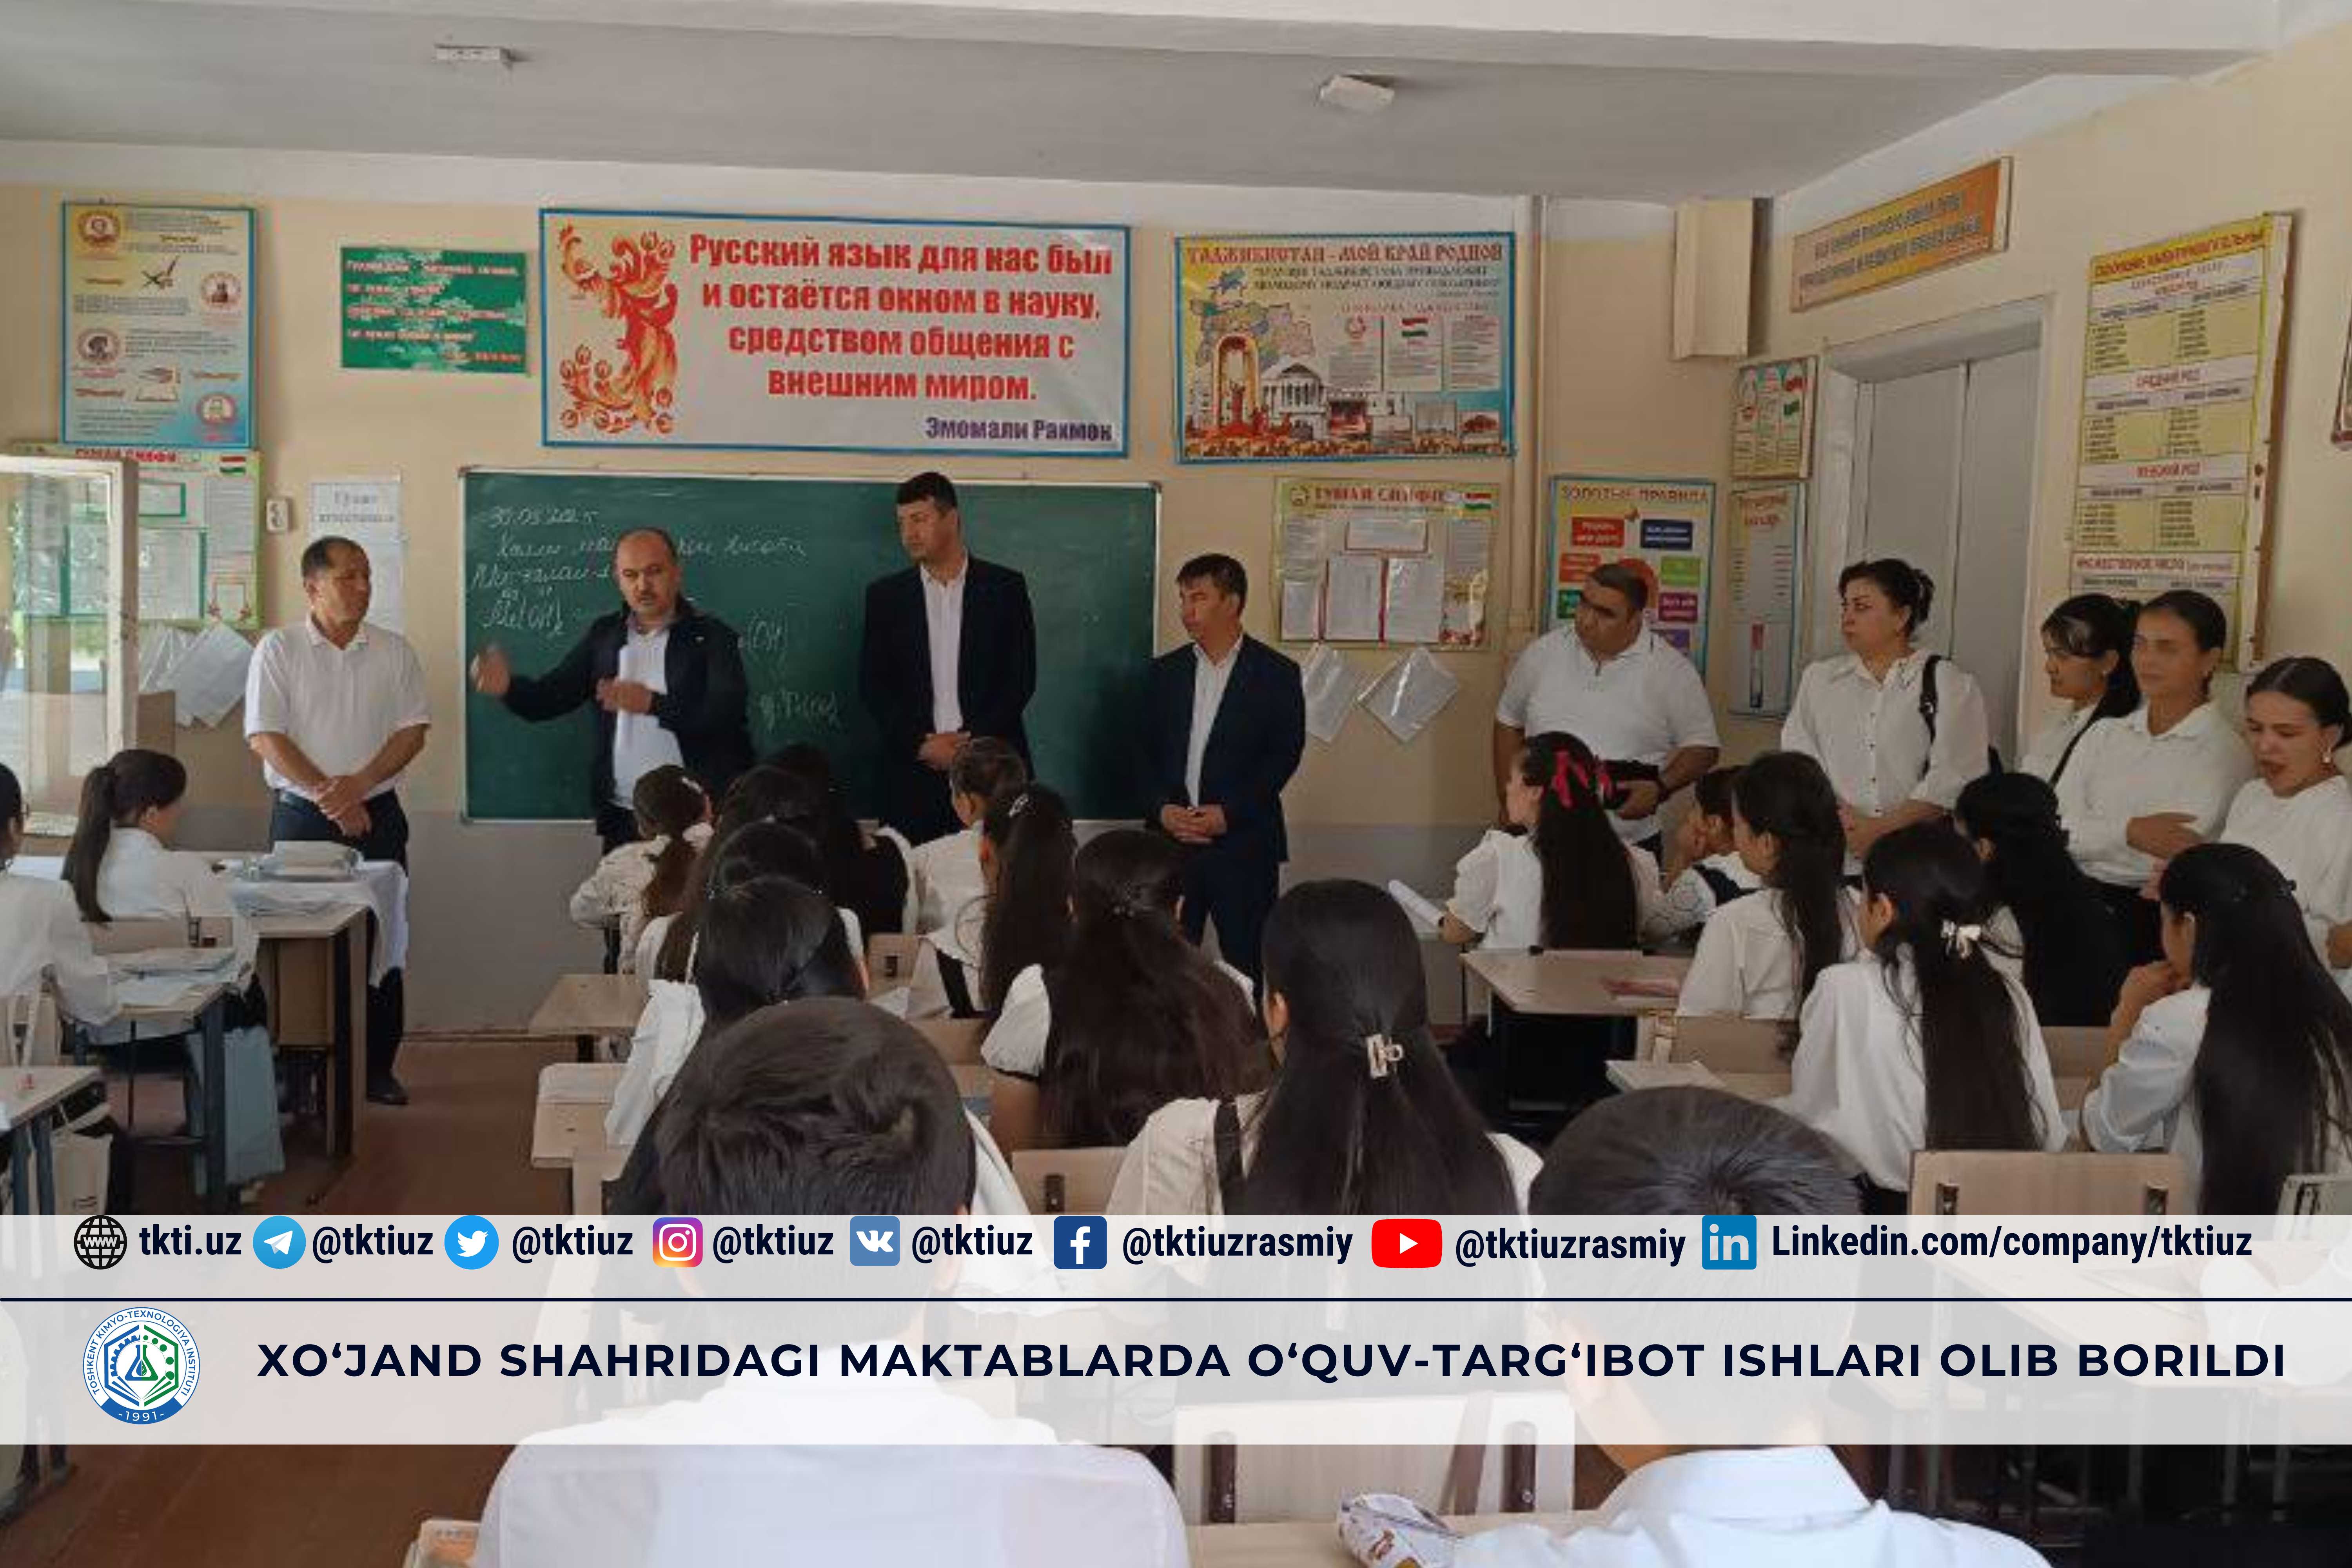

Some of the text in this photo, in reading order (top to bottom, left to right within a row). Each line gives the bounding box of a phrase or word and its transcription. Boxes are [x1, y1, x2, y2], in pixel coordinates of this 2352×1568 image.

[690, 233, 1112, 275] Русский язык для нас был
[1188, 247, 1324, 263] ТАДЖИКИСТАН
[1338, 243, 1379, 261] МОЙ
[1385, 242, 1431, 261] КРАЙ
[1436, 243, 1502, 263] РОДНОЙ
[703, 278, 1100, 320] и остаётся окном в науку,
[730, 326, 1074, 359] средством общения с
[768, 369, 1037, 402] внешним миром.
[926, 417, 1112, 442] Эмомали Рахмон
